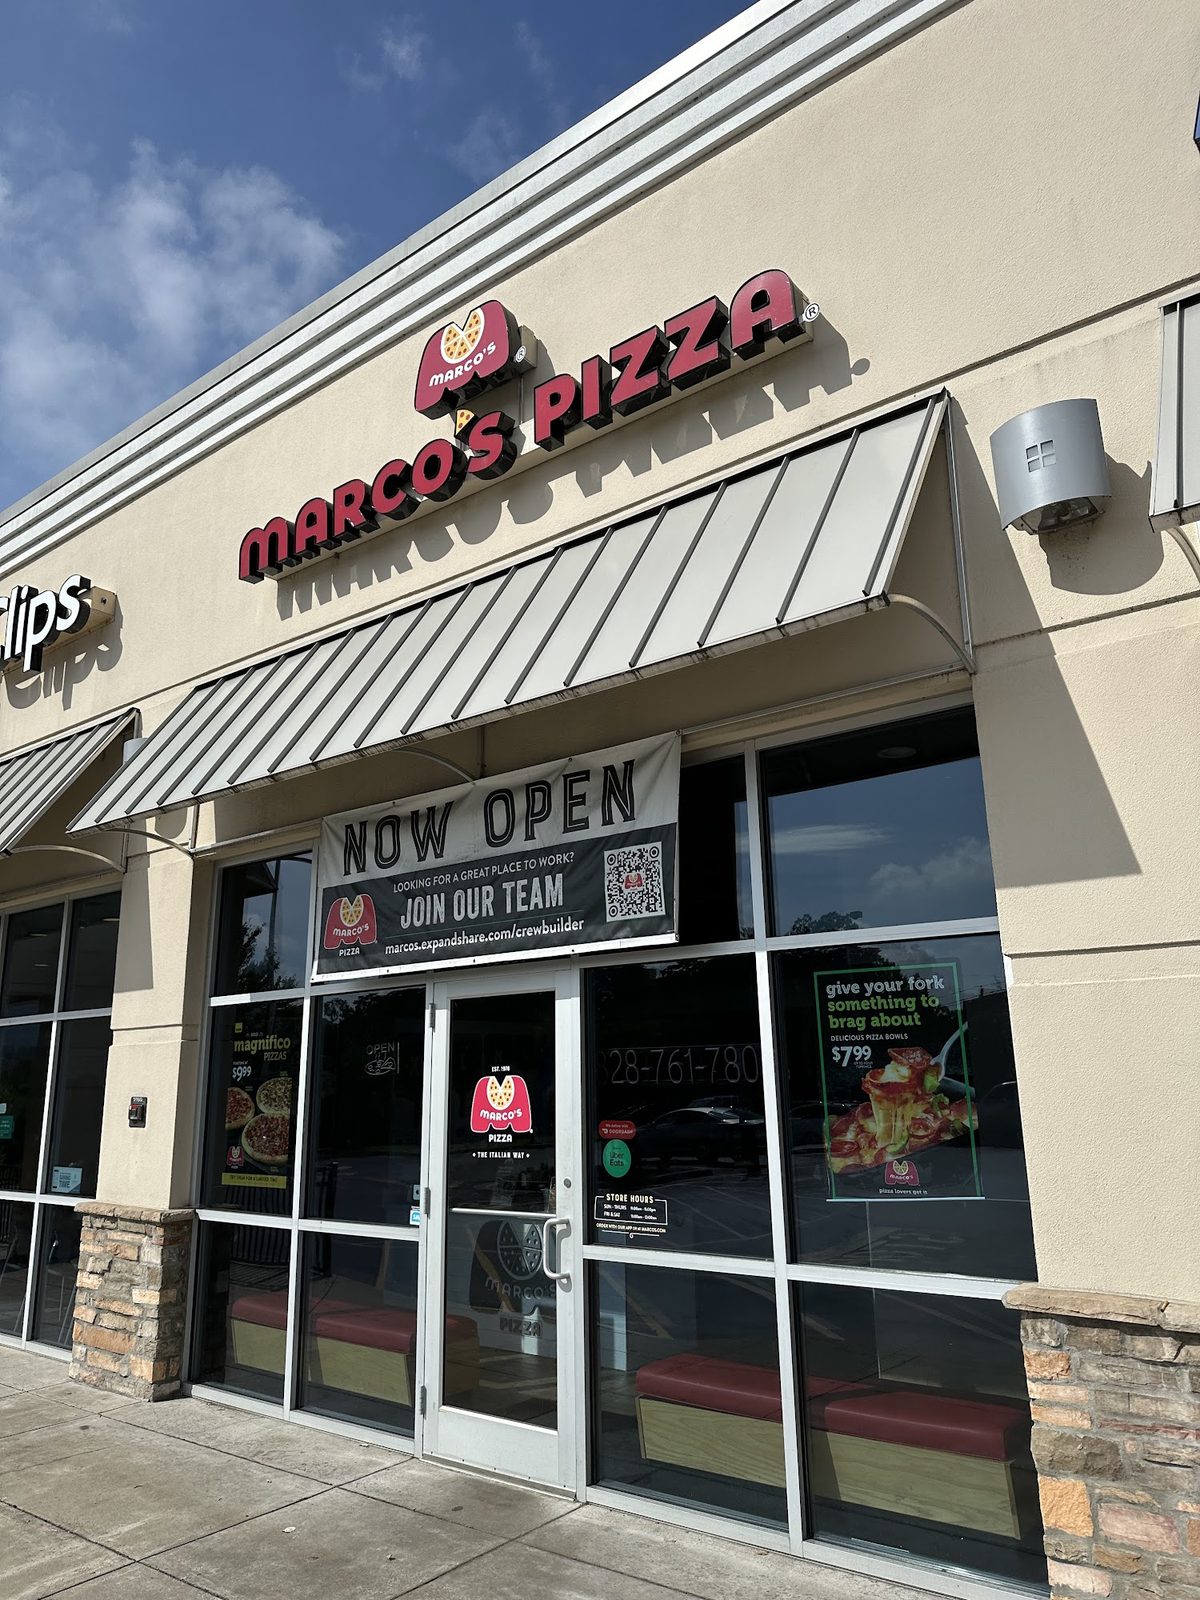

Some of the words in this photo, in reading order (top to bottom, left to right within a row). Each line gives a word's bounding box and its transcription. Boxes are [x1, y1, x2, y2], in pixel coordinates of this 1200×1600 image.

[429, 341, 497, 387] MARCO'S
[239, 410, 515, 582] MARCO'S
[534, 269, 804, 448] PIZZA
[0, 574, 84, 673] lips
[343, 801, 455, 876] NOW
[483, 759, 636, 848] OPEN
[393, 877, 431, 893] LOOKING
[433, 873, 451, 886] FOR
[452, 872, 459, 883] A
[460, 866, 490, 881] GREAT
[491, 862, 522, 876] PLACE
[523, 859, 537, 870] TO
[538, 851, 575, 867] WORK?
[400, 892, 446, 930] JOIN
[453, 884, 495, 922] OUR
[502, 873, 564, 914] TEAM
[332, 923, 370, 937] MARCO'S
[385, 916, 585, 955] marcos.expandshare.com/crewbuilder
[339, 947, 360, 957] PIZZA
[826, 981, 860, 999] give
[864, 979, 904, 997] your
[908, 975, 945, 991] fork
[827, 995, 917, 1012] something
[921, 994, 940, 1008] to
[828, 1014, 867, 1031] brag
[870, 1012, 922, 1028] about
[233, 1034, 291, 1055] magnifico
[830, 1034, 865, 1042] DELICIOUS
[263, 1051, 288, 1061] PIZZAS
[366, 1041, 395, 1055] OPEN
[831, 1045, 872, 1067] $799
[480, 1108, 523, 1121] MARCO'S
[488, 1134, 513, 1143] PIZZA
[609, 1151, 625, 1159] Uber
[609, 1158, 625, 1167] Eats
[605, 1193, 628, 1203] STORE
[630, 1194, 654, 1204] HOURS
